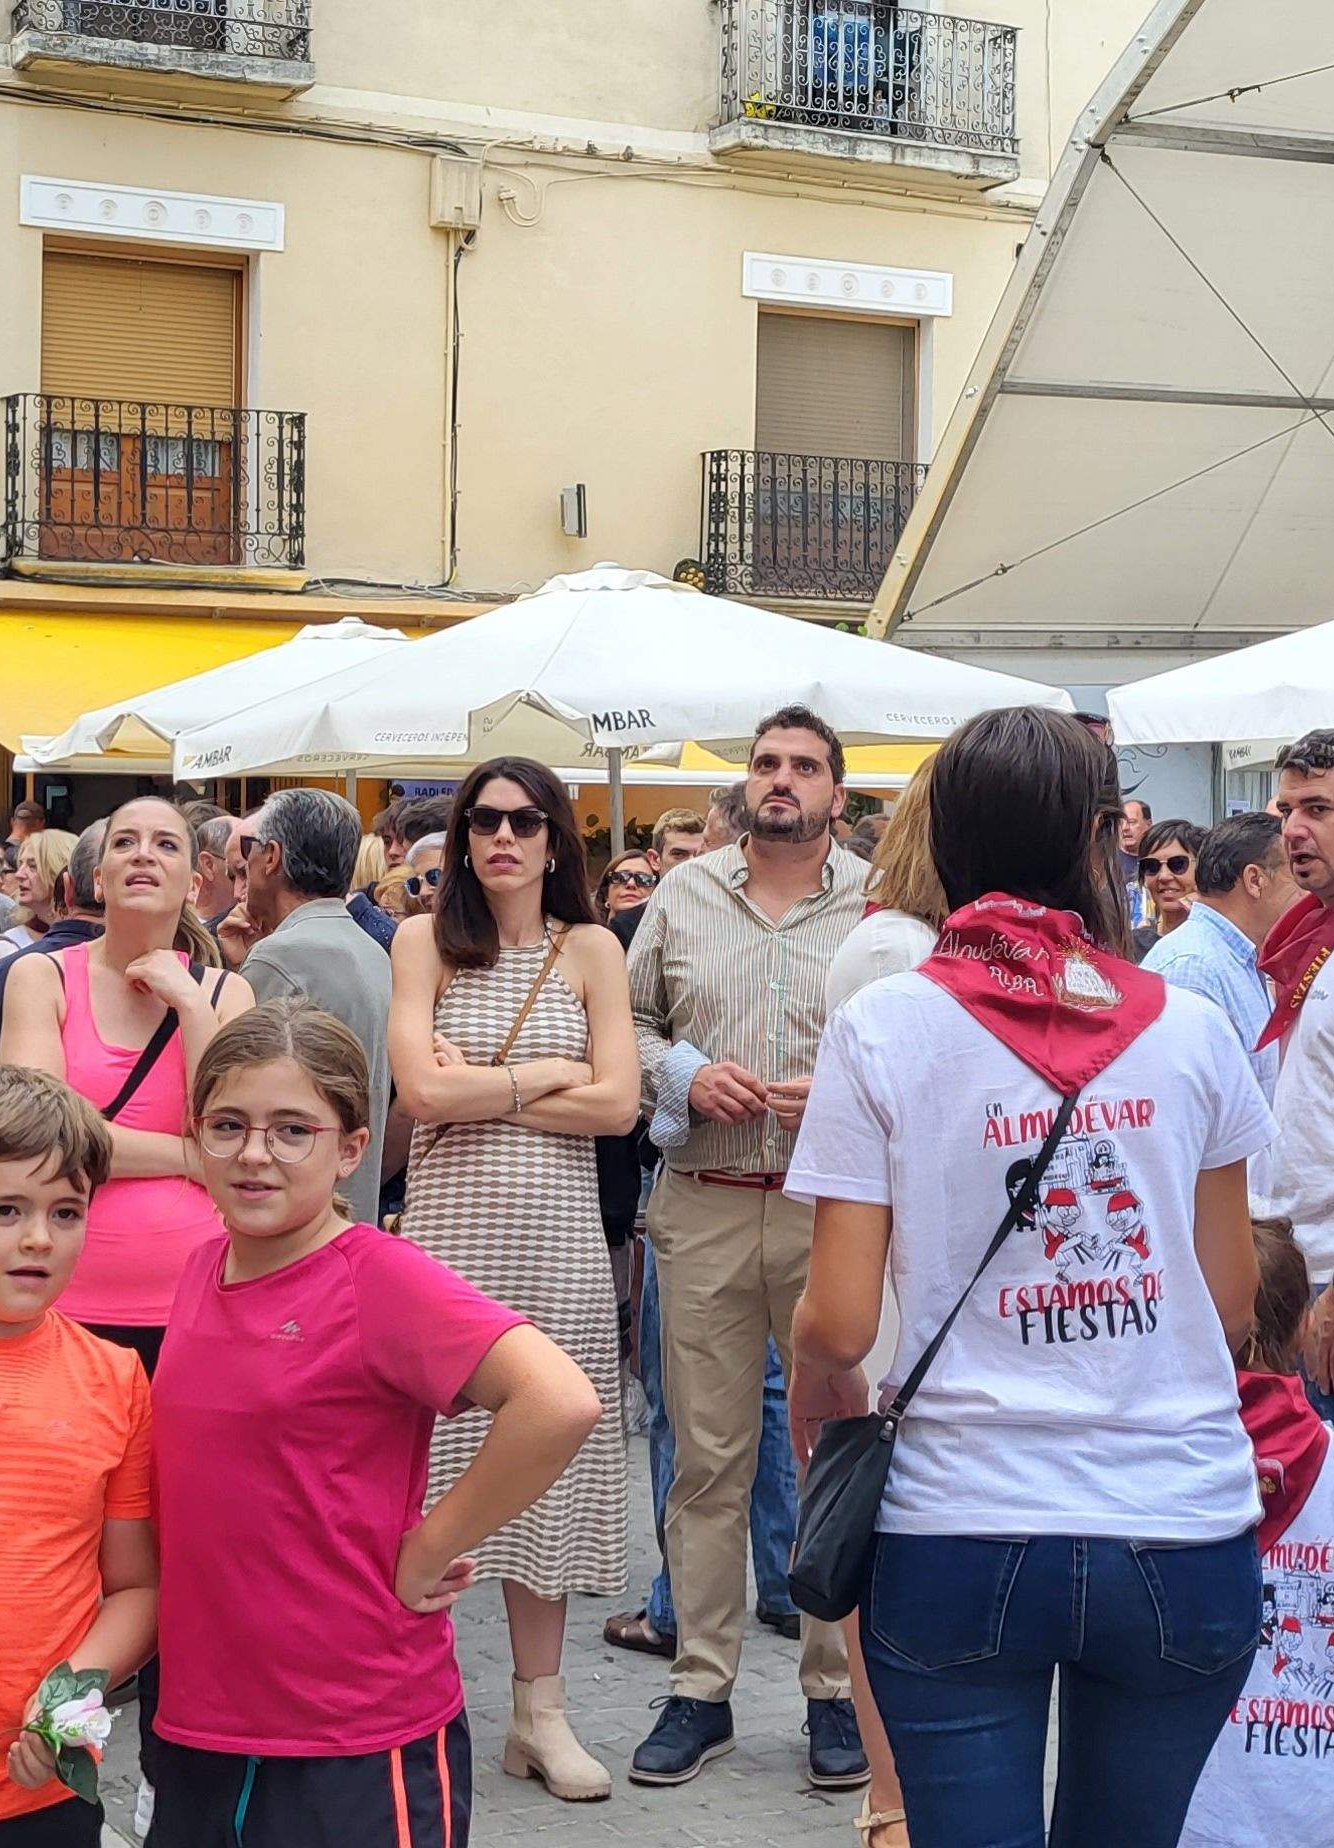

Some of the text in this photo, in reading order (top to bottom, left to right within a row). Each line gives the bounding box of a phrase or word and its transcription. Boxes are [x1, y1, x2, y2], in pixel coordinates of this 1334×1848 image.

[591, 708, 657, 734] MBAR
[190, 745, 232, 770] AMBAR
[989, 964, 1045, 997] ALBA
[985, 1101, 1004, 1119] EN
[998, 1274, 1132, 1320] ESTAMOS
[1019, 1297, 1159, 1346] FIESTAS
